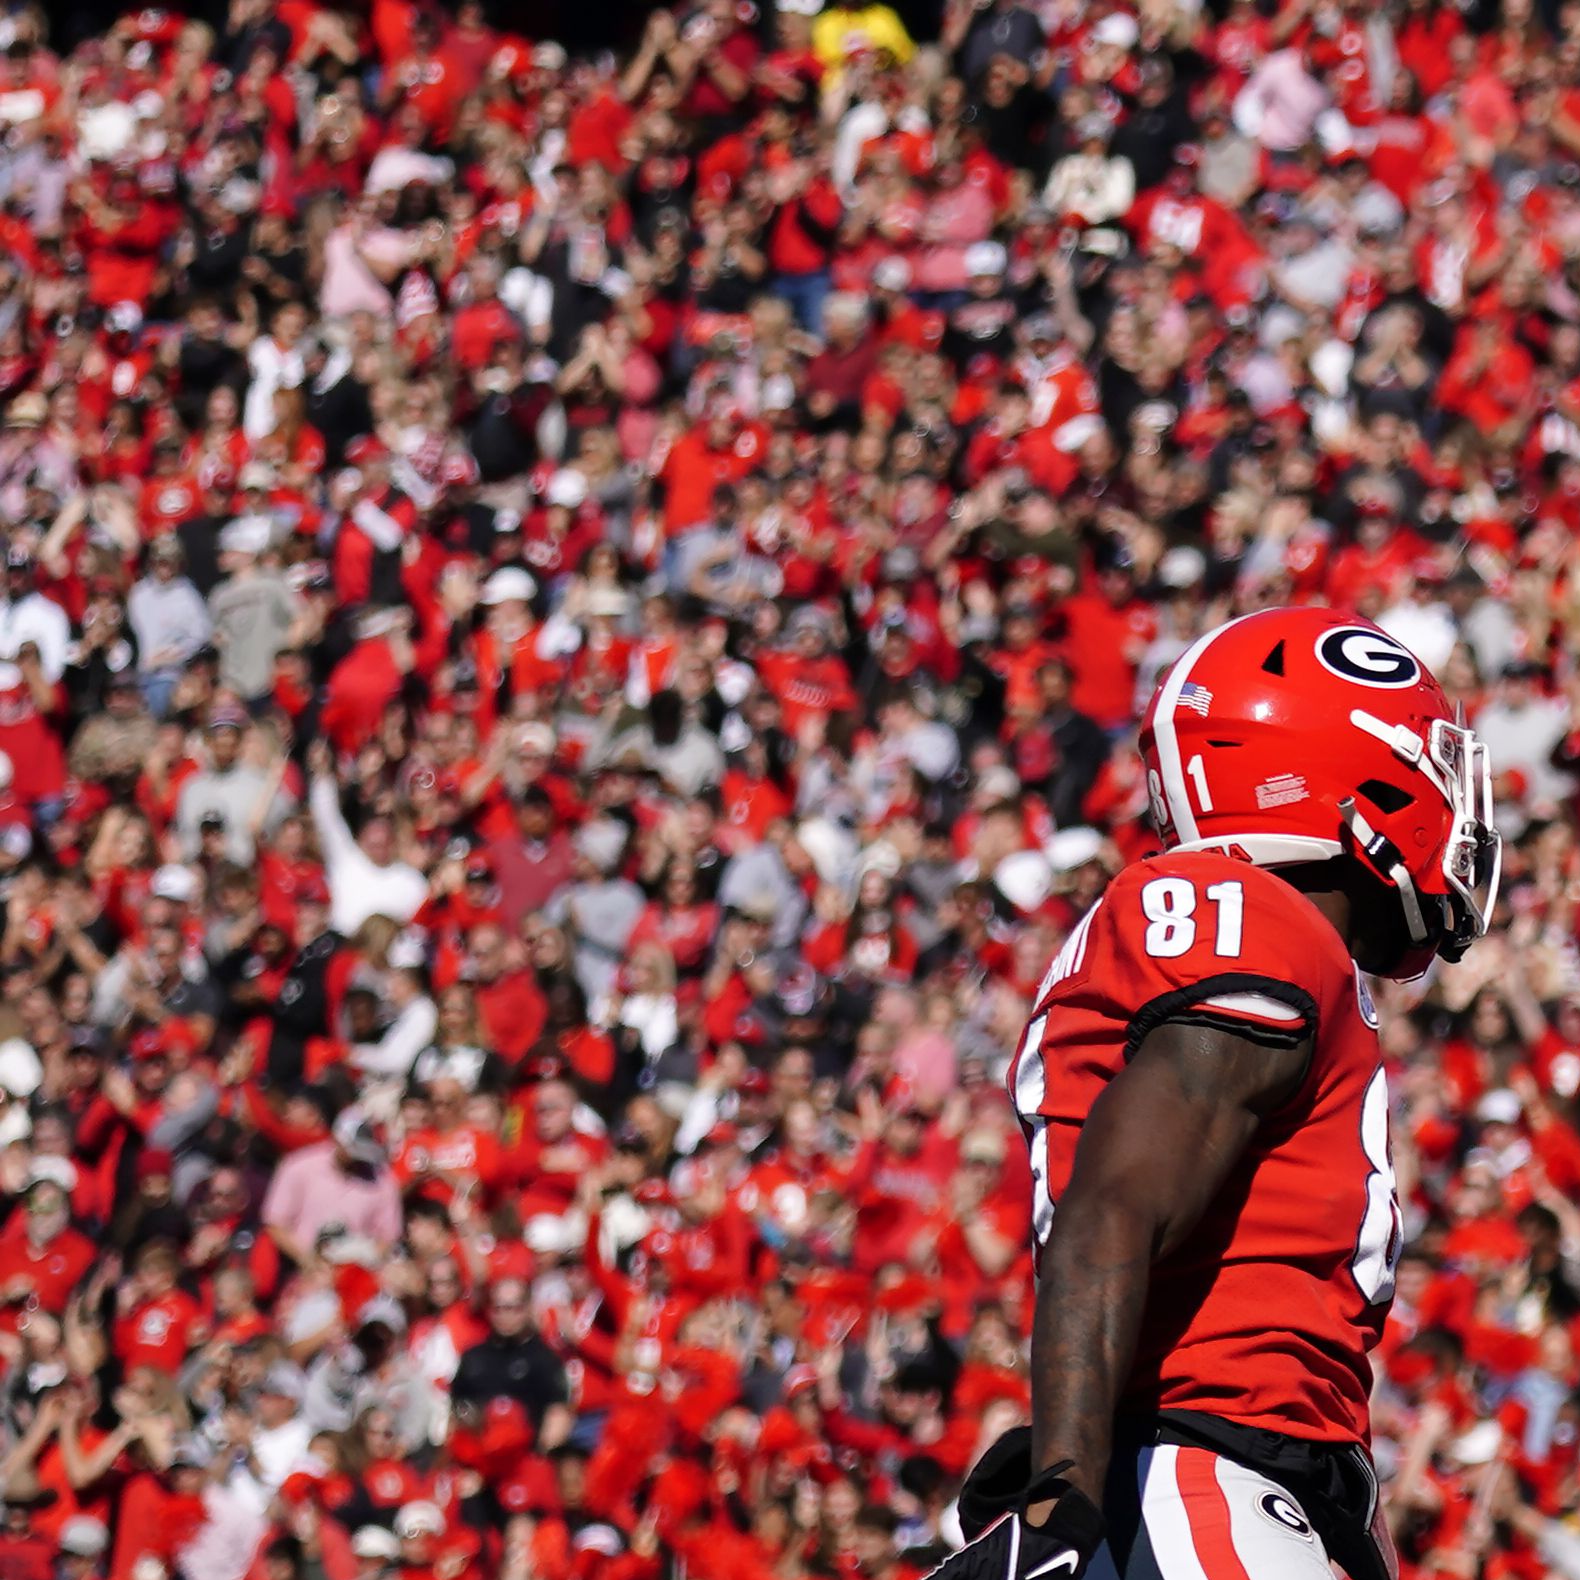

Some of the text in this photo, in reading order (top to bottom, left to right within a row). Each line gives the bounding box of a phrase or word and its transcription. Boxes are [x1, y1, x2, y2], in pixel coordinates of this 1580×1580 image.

[1317, 627, 1420, 688] G
[1141, 877, 1245, 959] 81
[1259, 1491, 1312, 1541] G
